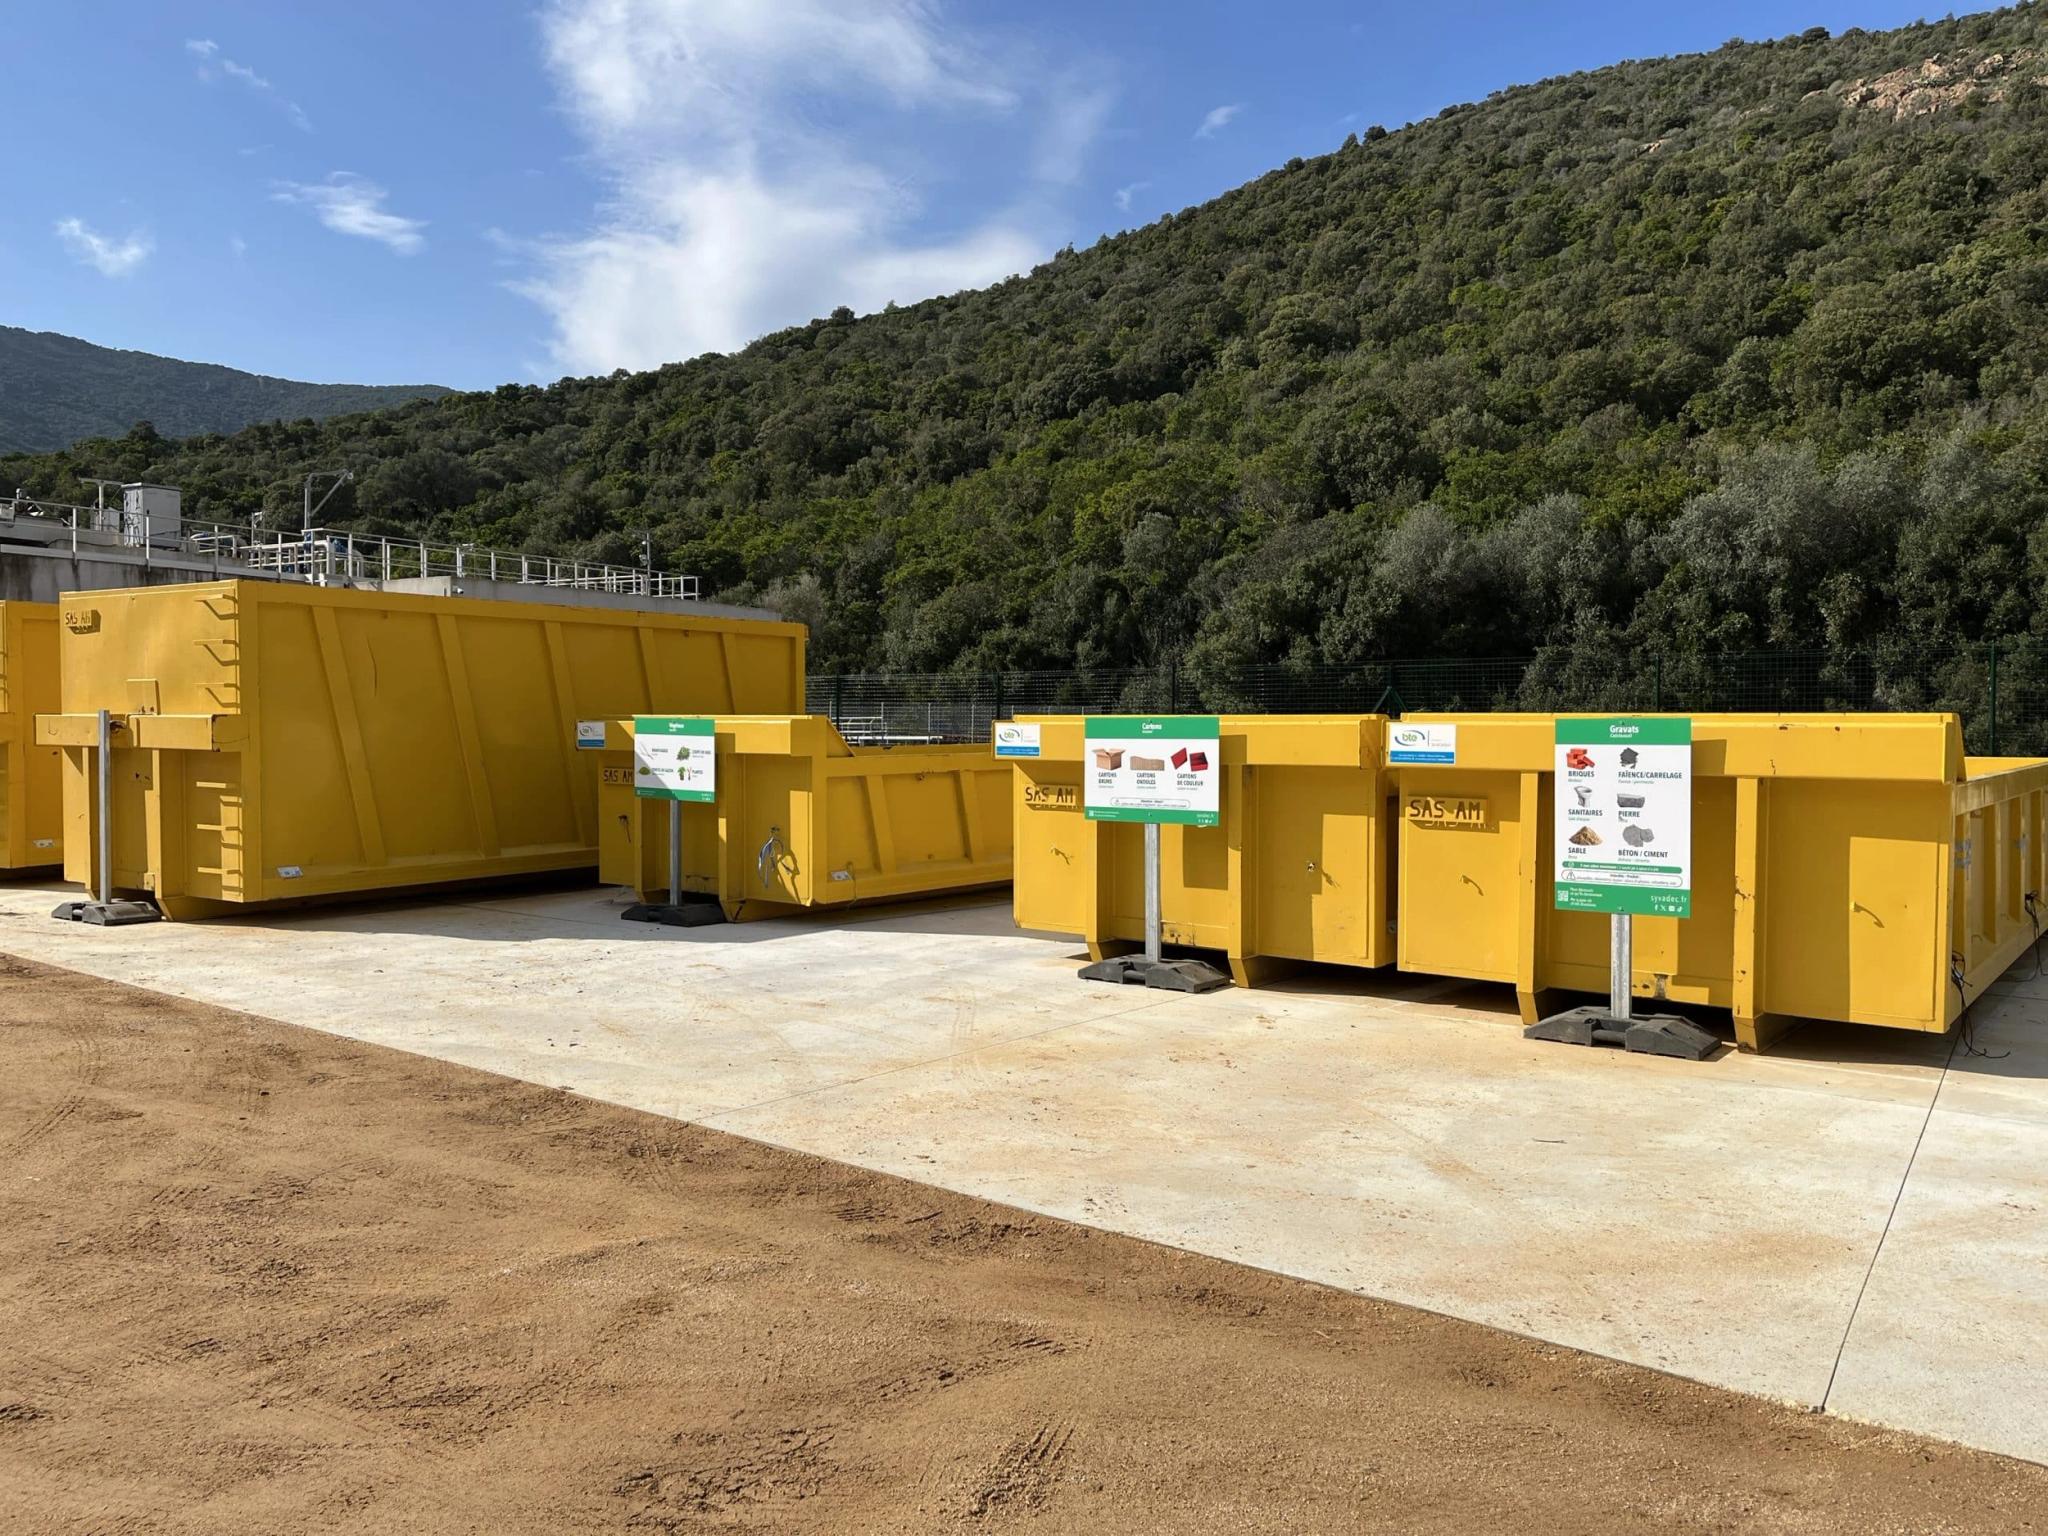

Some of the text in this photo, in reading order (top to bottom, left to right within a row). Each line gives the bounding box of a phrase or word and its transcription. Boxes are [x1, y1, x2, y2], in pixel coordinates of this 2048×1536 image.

[1609, 725, 1639, 734] Gravats
[603, 769, 618, 782] SAS
[1568, 770, 1595, 778] BRIQUES
[1618, 769, 1683, 779] FAÏENCE/CARRELAGE
[1025, 787, 1074, 803] SAS AM
[1409, 799, 1481, 821] SAS AM
[1568, 809, 1603, 817] SANITAIRES
[1618, 810, 1640, 818] PIERRE
[1568, 847, 1587, 855] SABLE
[1618, 848, 1639, 857] BÉTON
[1643, 850, 1668, 858] CIMENT
[1651, 895, 1687, 903] syvadec.fr
